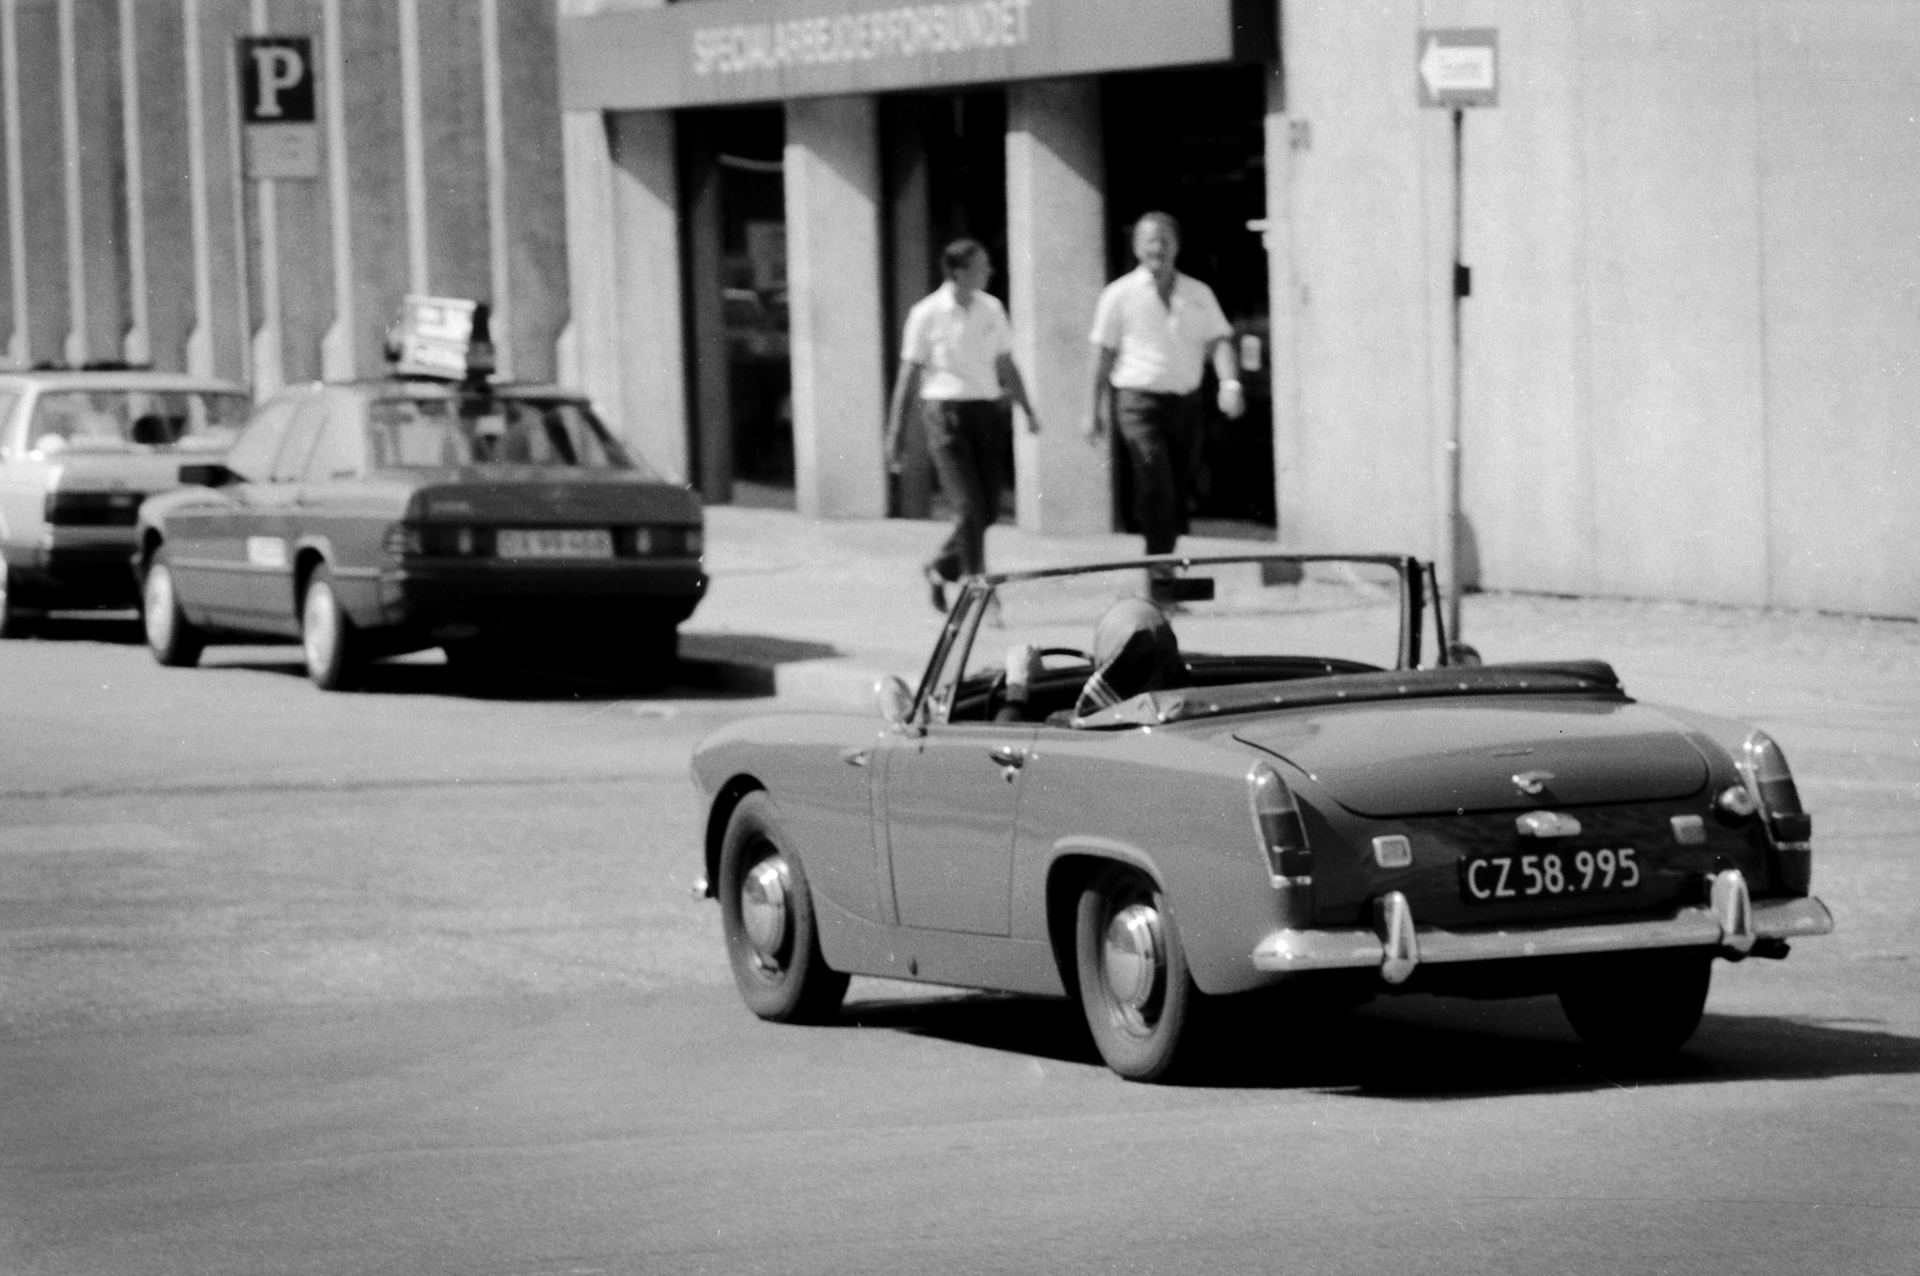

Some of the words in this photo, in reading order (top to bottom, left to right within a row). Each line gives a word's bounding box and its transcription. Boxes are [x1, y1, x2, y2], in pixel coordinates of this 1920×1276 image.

[252, 46, 304, 117] P
[1468, 858, 1516, 898] CZ
[1521, 848, 1640, 893] 58.995
